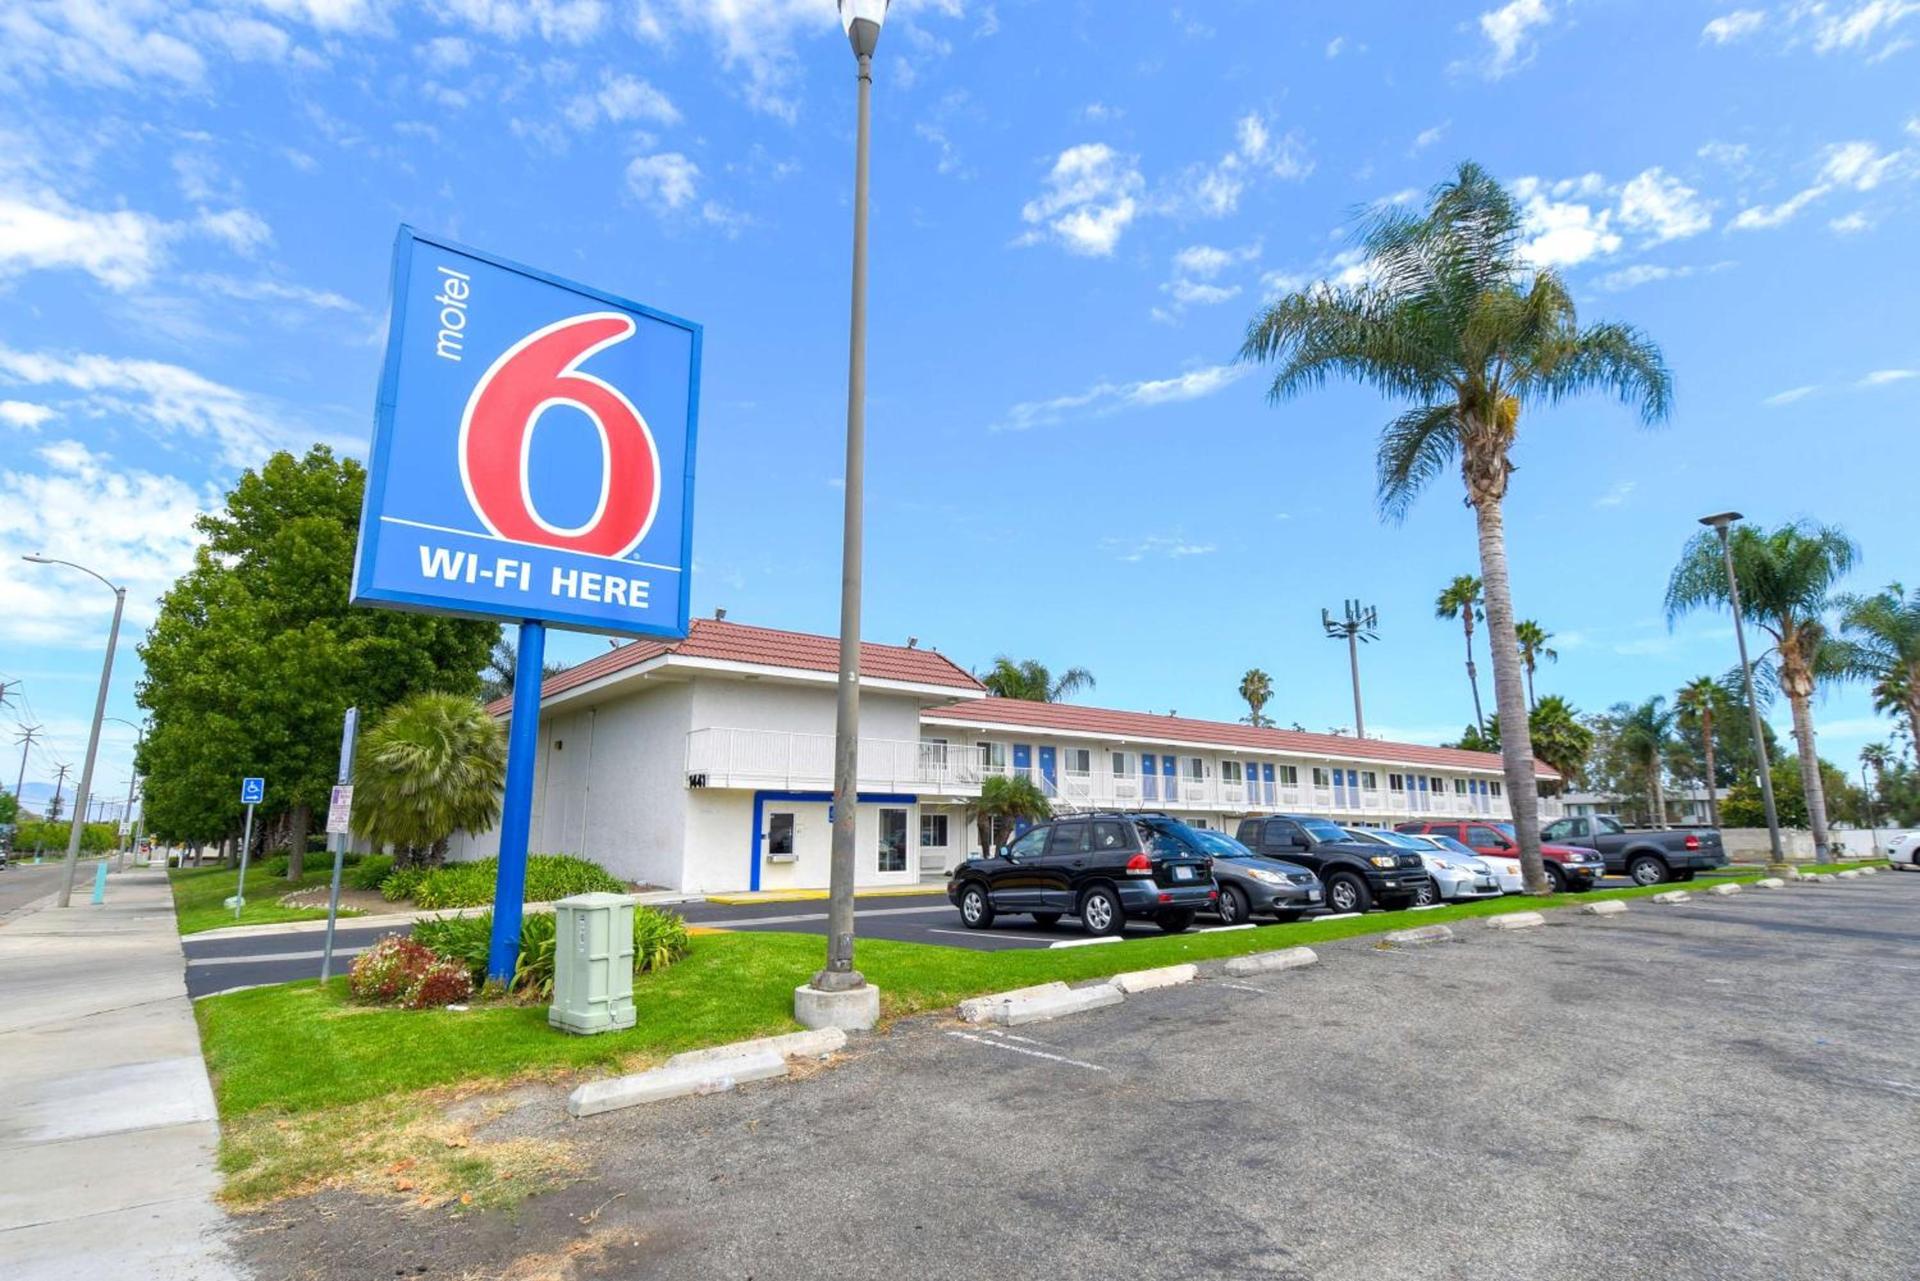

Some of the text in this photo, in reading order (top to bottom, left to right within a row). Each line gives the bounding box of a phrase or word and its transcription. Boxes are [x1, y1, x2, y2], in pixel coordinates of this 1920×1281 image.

[435, 267, 470, 361] motel
[457, 311, 661, 560] 6
[419, 545, 650, 609] WI-FI HERE
